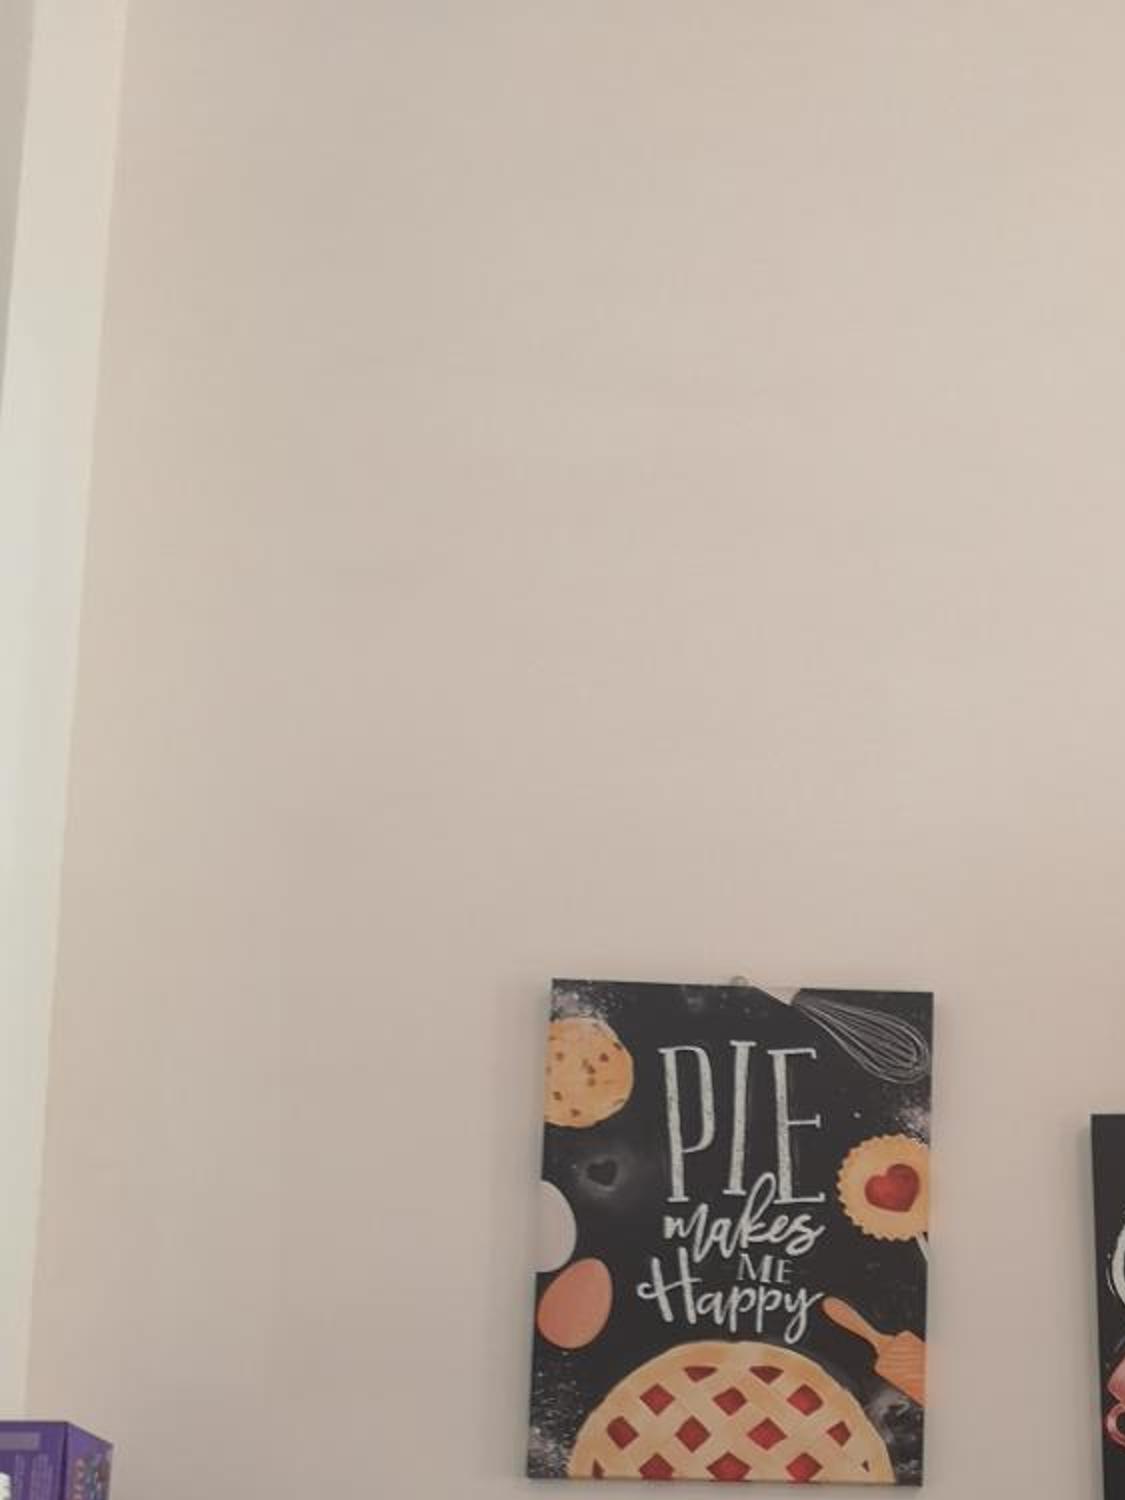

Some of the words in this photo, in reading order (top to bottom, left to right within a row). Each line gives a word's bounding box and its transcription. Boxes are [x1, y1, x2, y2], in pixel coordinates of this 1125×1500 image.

[658, 1039, 825, 1205] PIE
[663, 1171, 825, 1263] makes
[636, 1247, 825, 1345] Happy
[736, 1253, 793, 1284] ME
